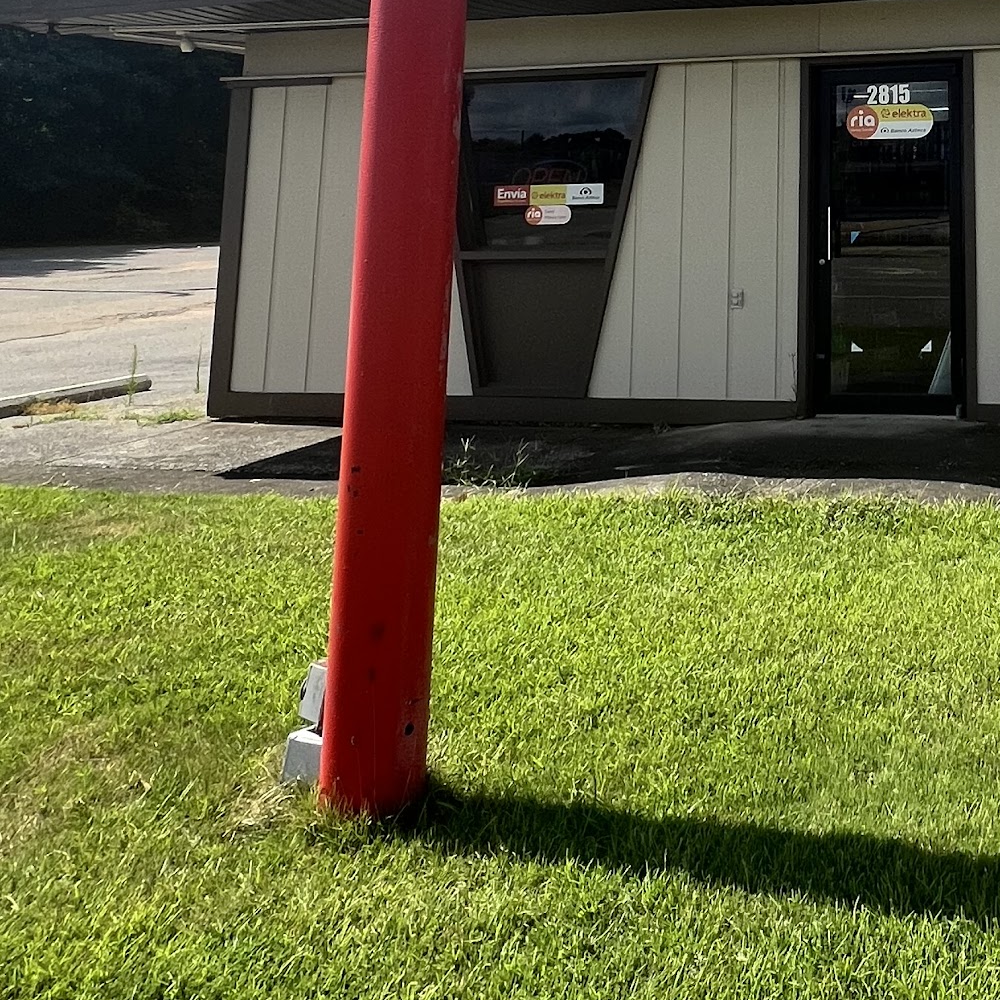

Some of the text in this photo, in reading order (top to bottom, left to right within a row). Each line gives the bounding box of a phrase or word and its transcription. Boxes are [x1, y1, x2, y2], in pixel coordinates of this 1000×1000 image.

[867, 84, 910, 105] 2815
[850, 110, 876, 127] ria
[892, 109, 926, 118] elektra
[527, 208, 541, 218] ria
